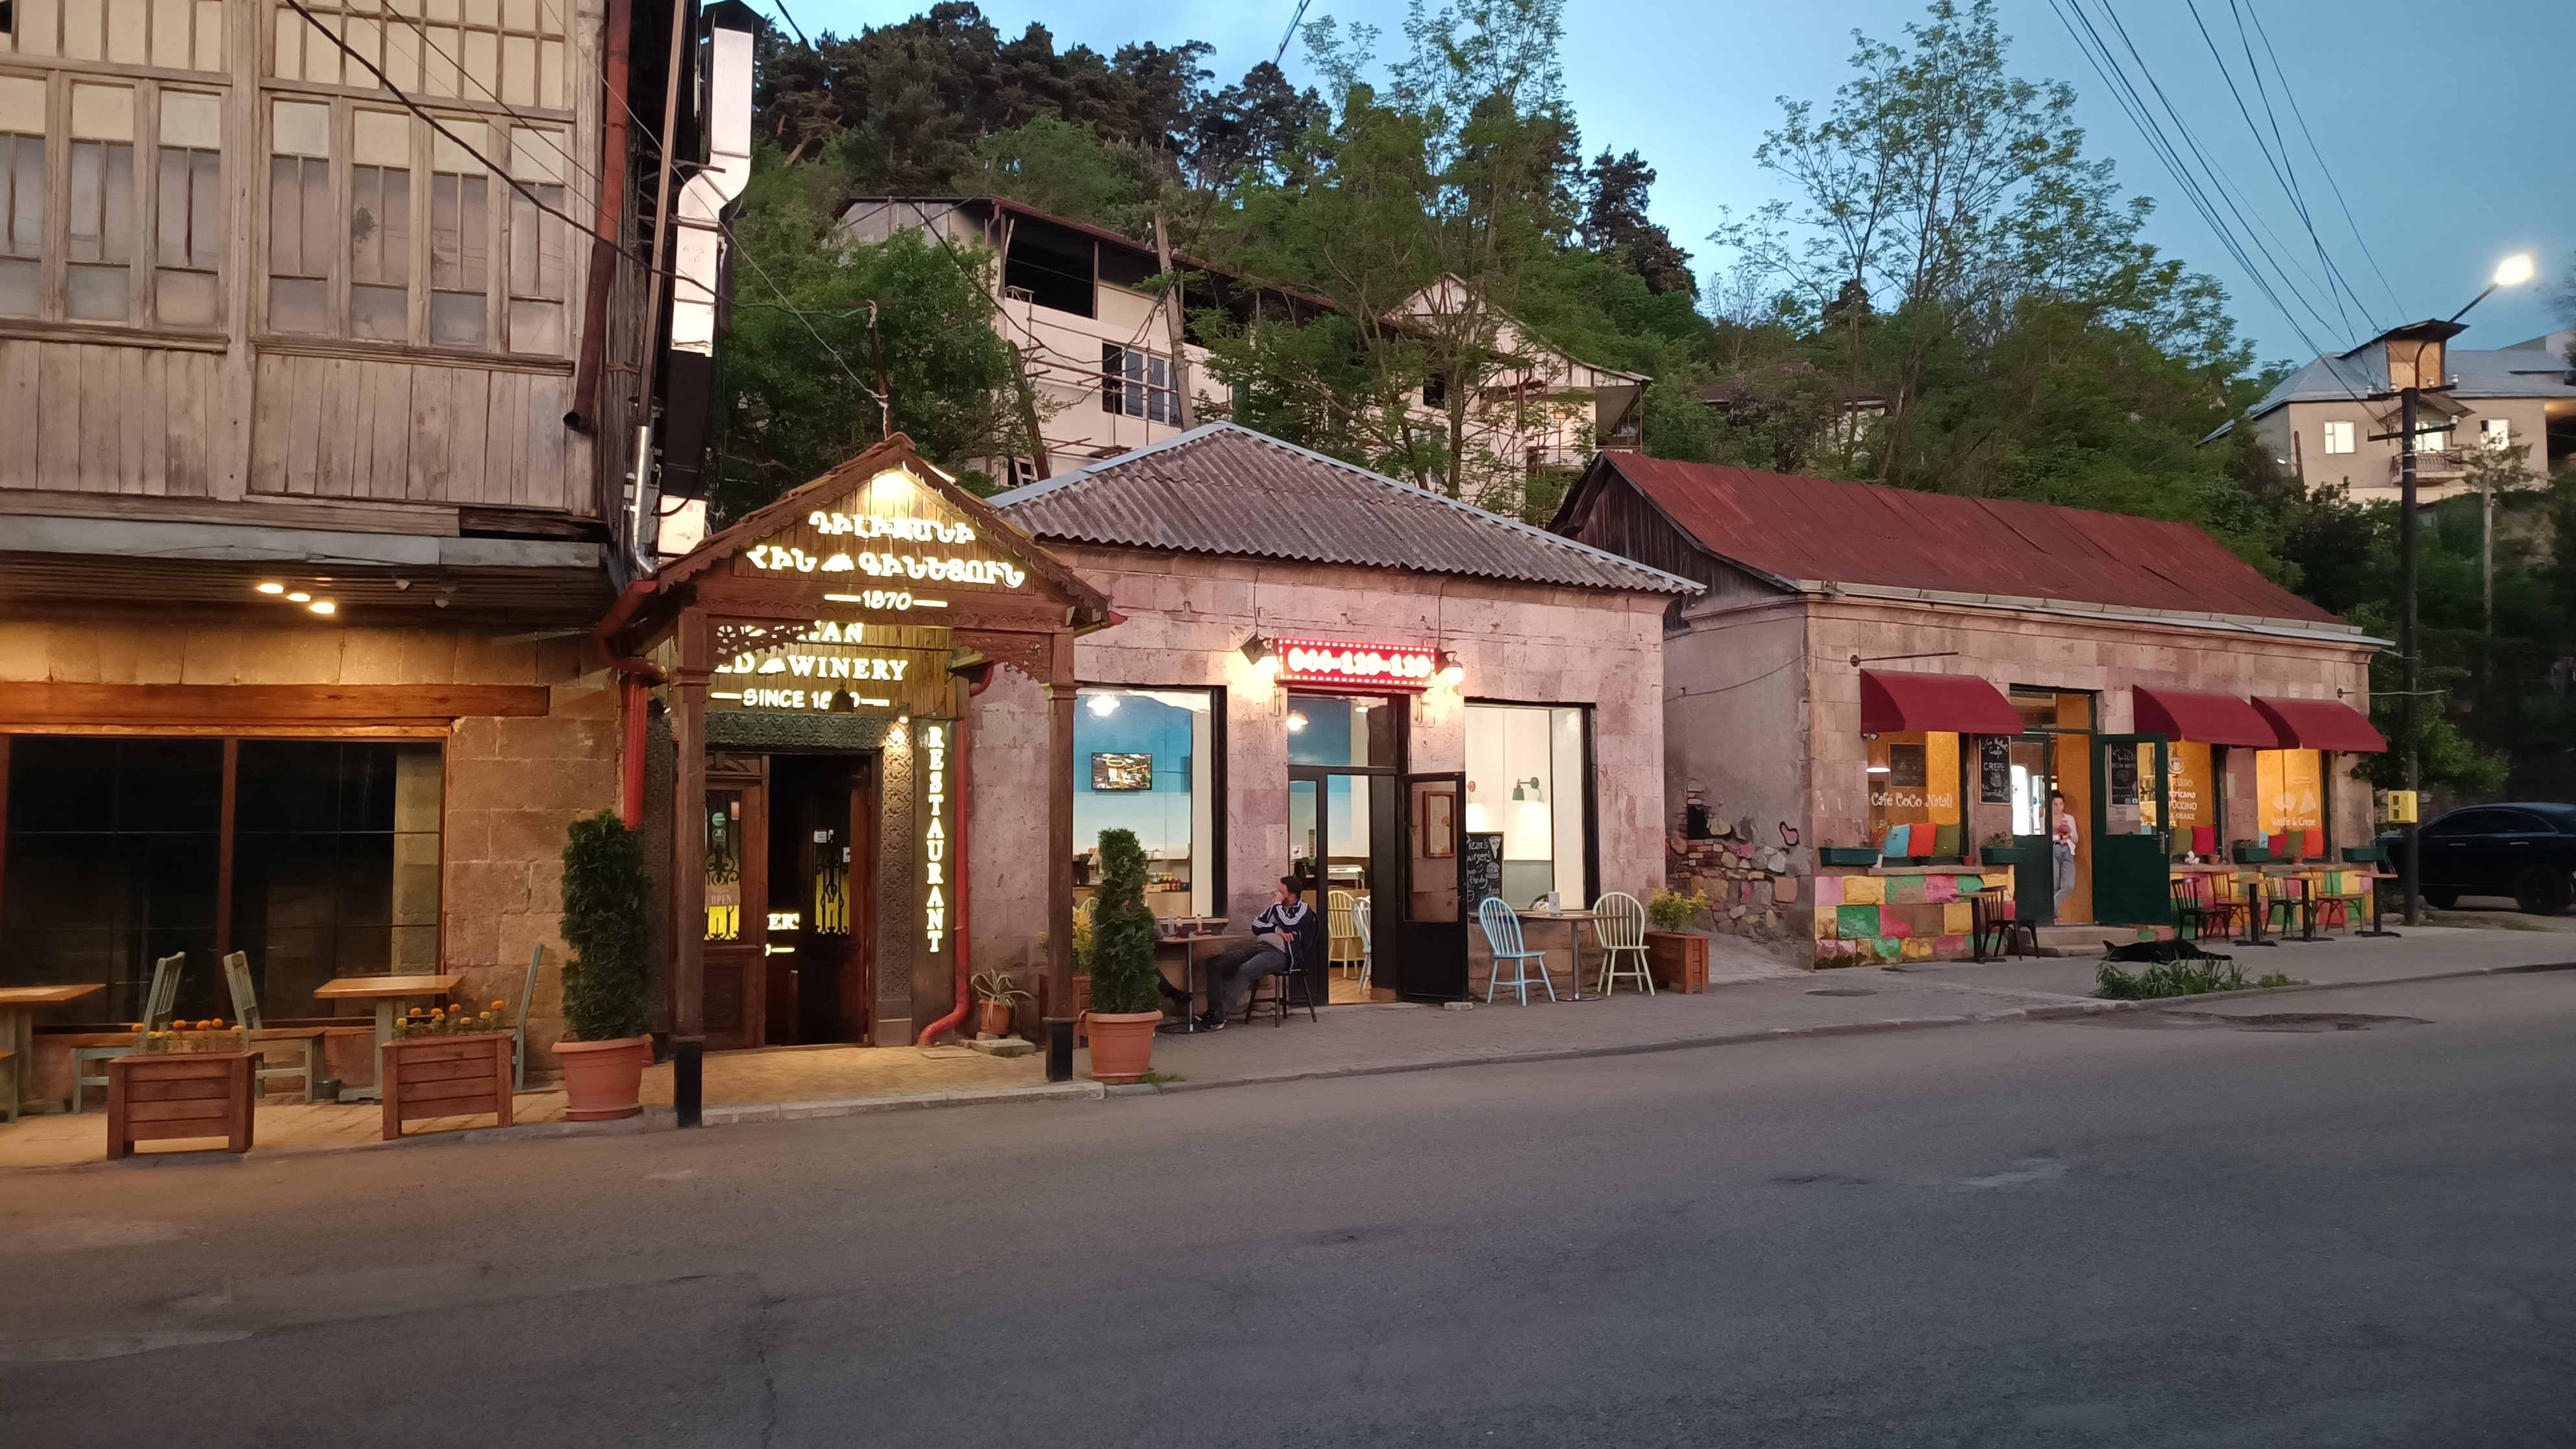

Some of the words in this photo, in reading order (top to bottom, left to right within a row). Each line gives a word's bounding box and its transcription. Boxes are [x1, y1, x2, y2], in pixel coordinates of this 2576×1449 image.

[862, 589, 912, 611] 1870
[786, 654, 909, 681] WINERY
[743, 688, 806, 709] SINCE
[811, 691, 861, 710] 180
[1983, 762, 2005, 771] CREPE
[1871, 791, 1893, 806] Café
[1925, 793, 1953, 808] Natali
[2292, 817, 2297, 826] &
[2299, 817, 2316, 828] Crepe
[926, 726, 945, 953] RESTAURANT
[711, 894, 732, 905] OPEN
